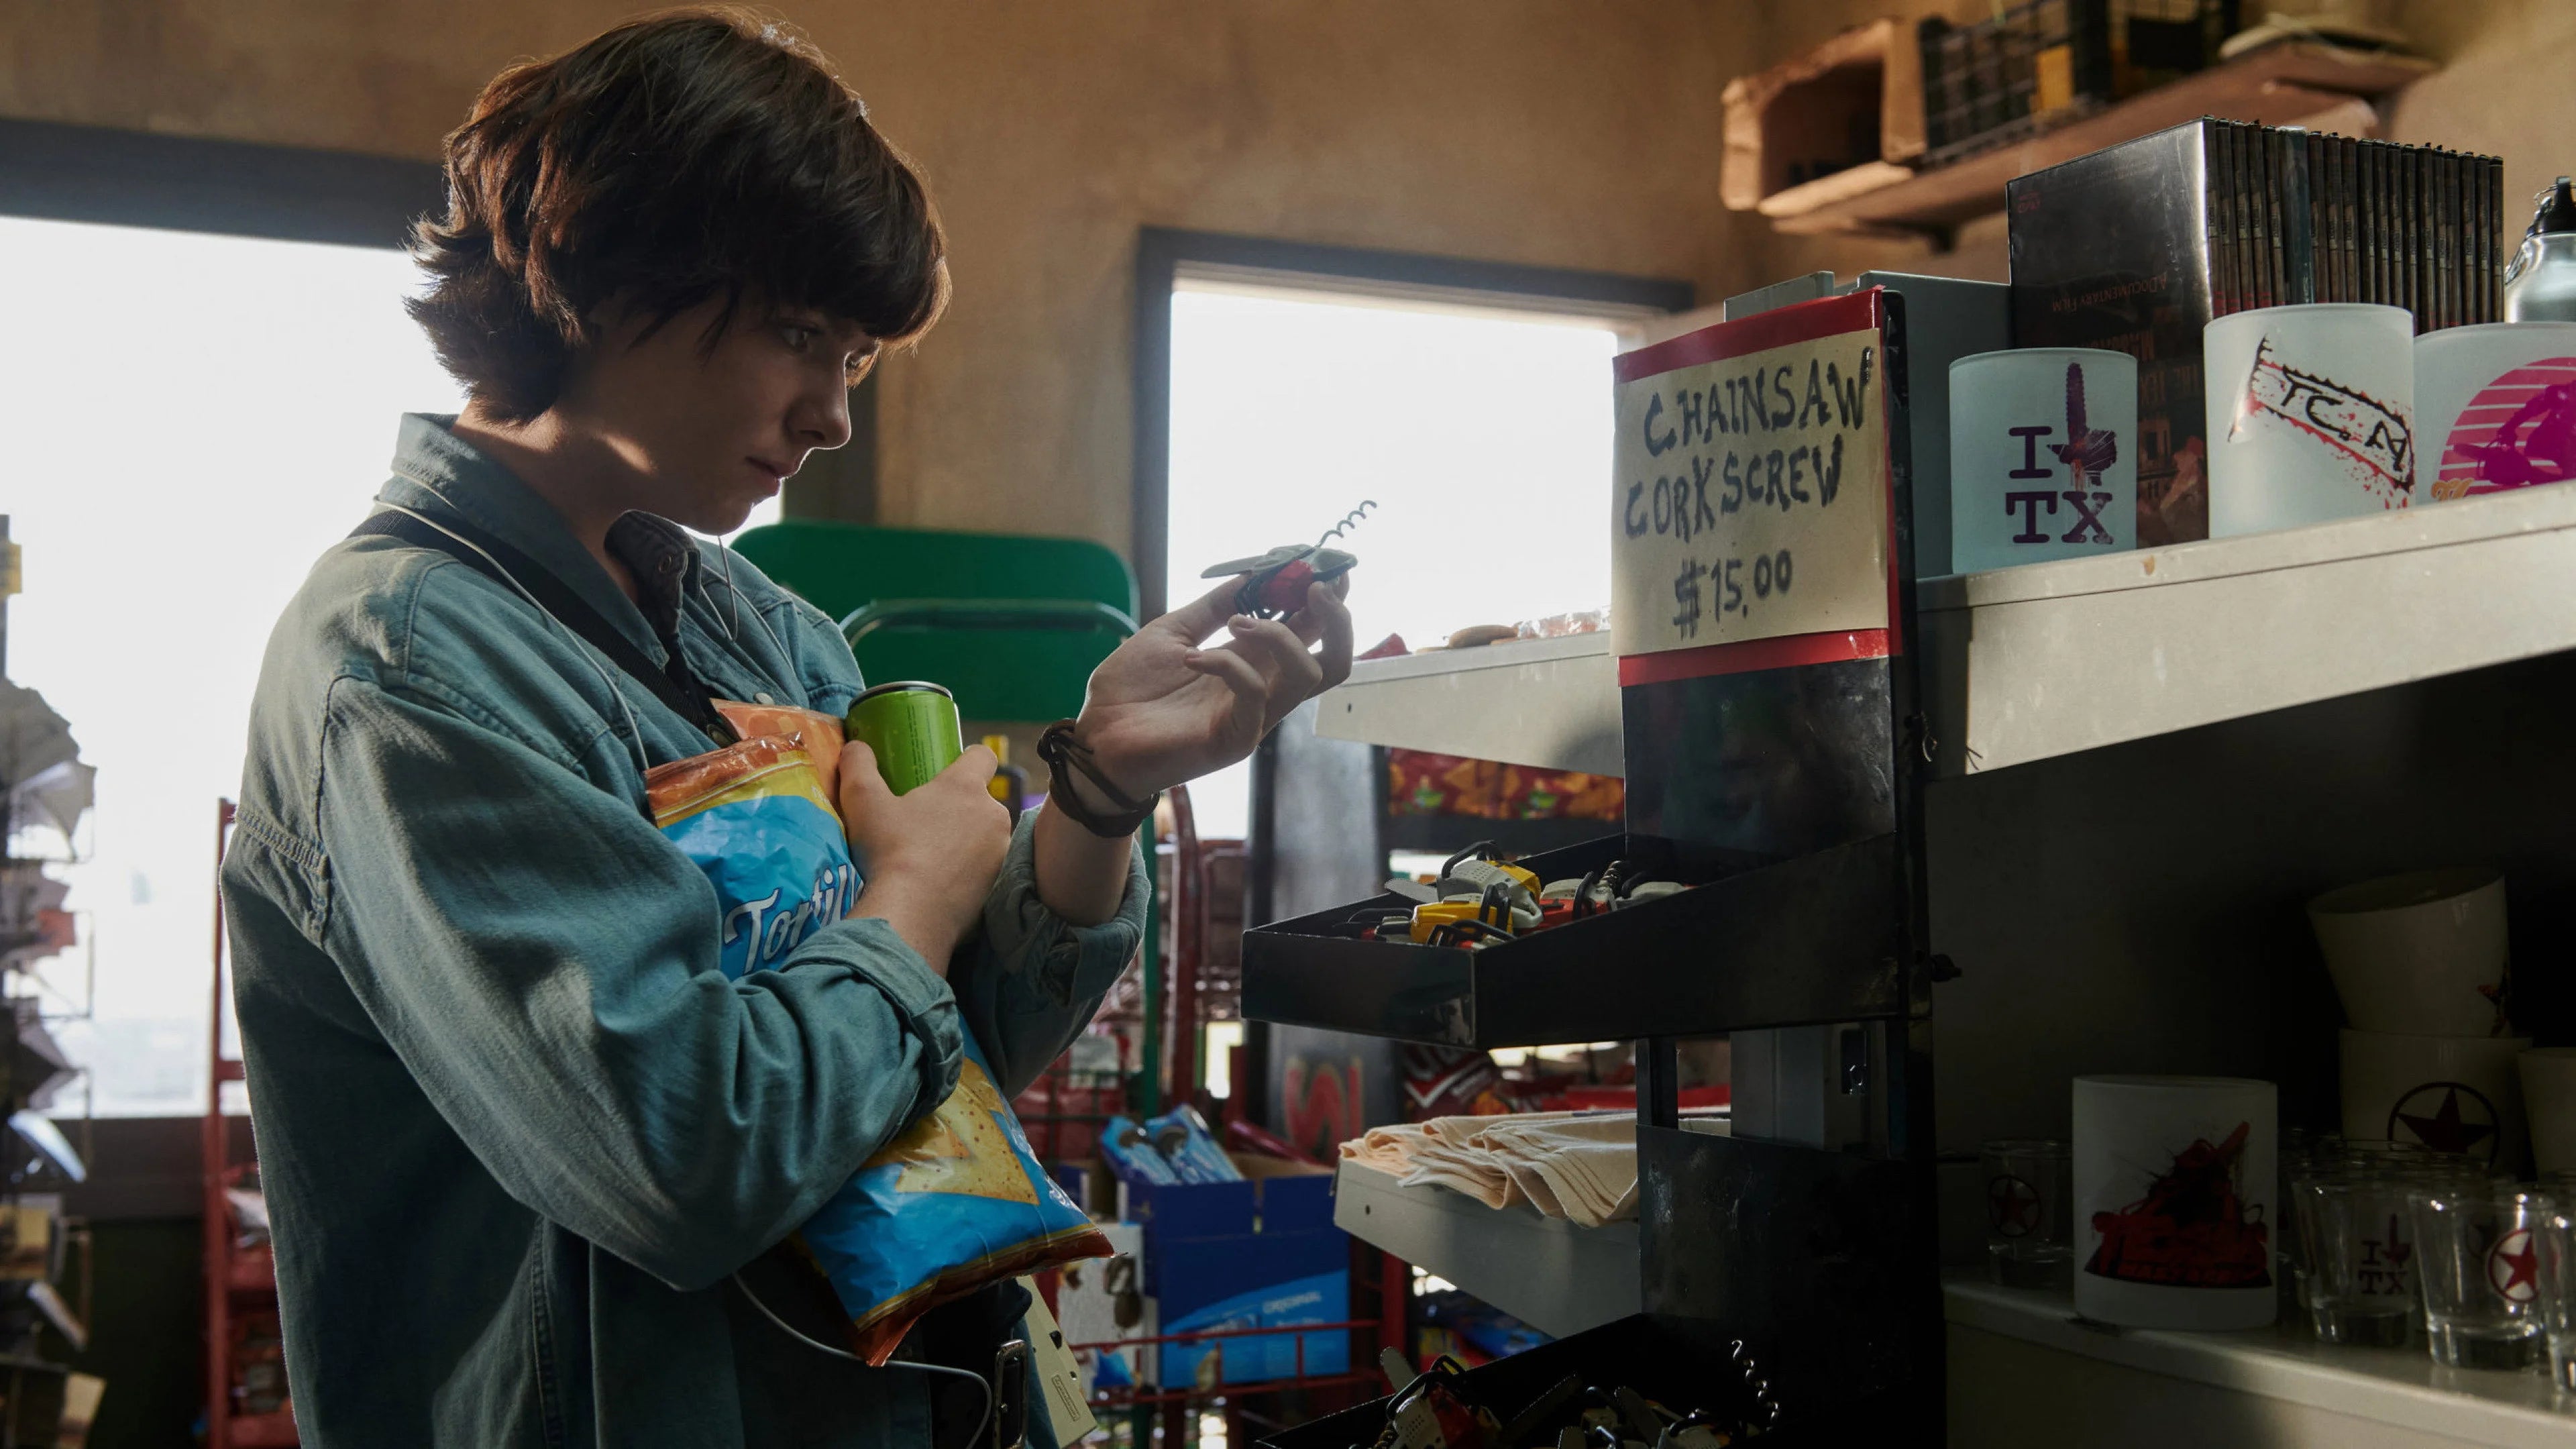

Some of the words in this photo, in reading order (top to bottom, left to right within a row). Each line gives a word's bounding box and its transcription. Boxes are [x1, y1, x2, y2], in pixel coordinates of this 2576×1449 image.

[1644, 347, 1874, 458] CHAINSAW
[1624, 433, 1843, 543] CORKSCREW
[2008, 426, 2053, 479] I
[2004, 492, 2114, 544] TX
[1672, 549, 1792, 639] $15.00
[2357, 1271, 2408, 1295] TX
